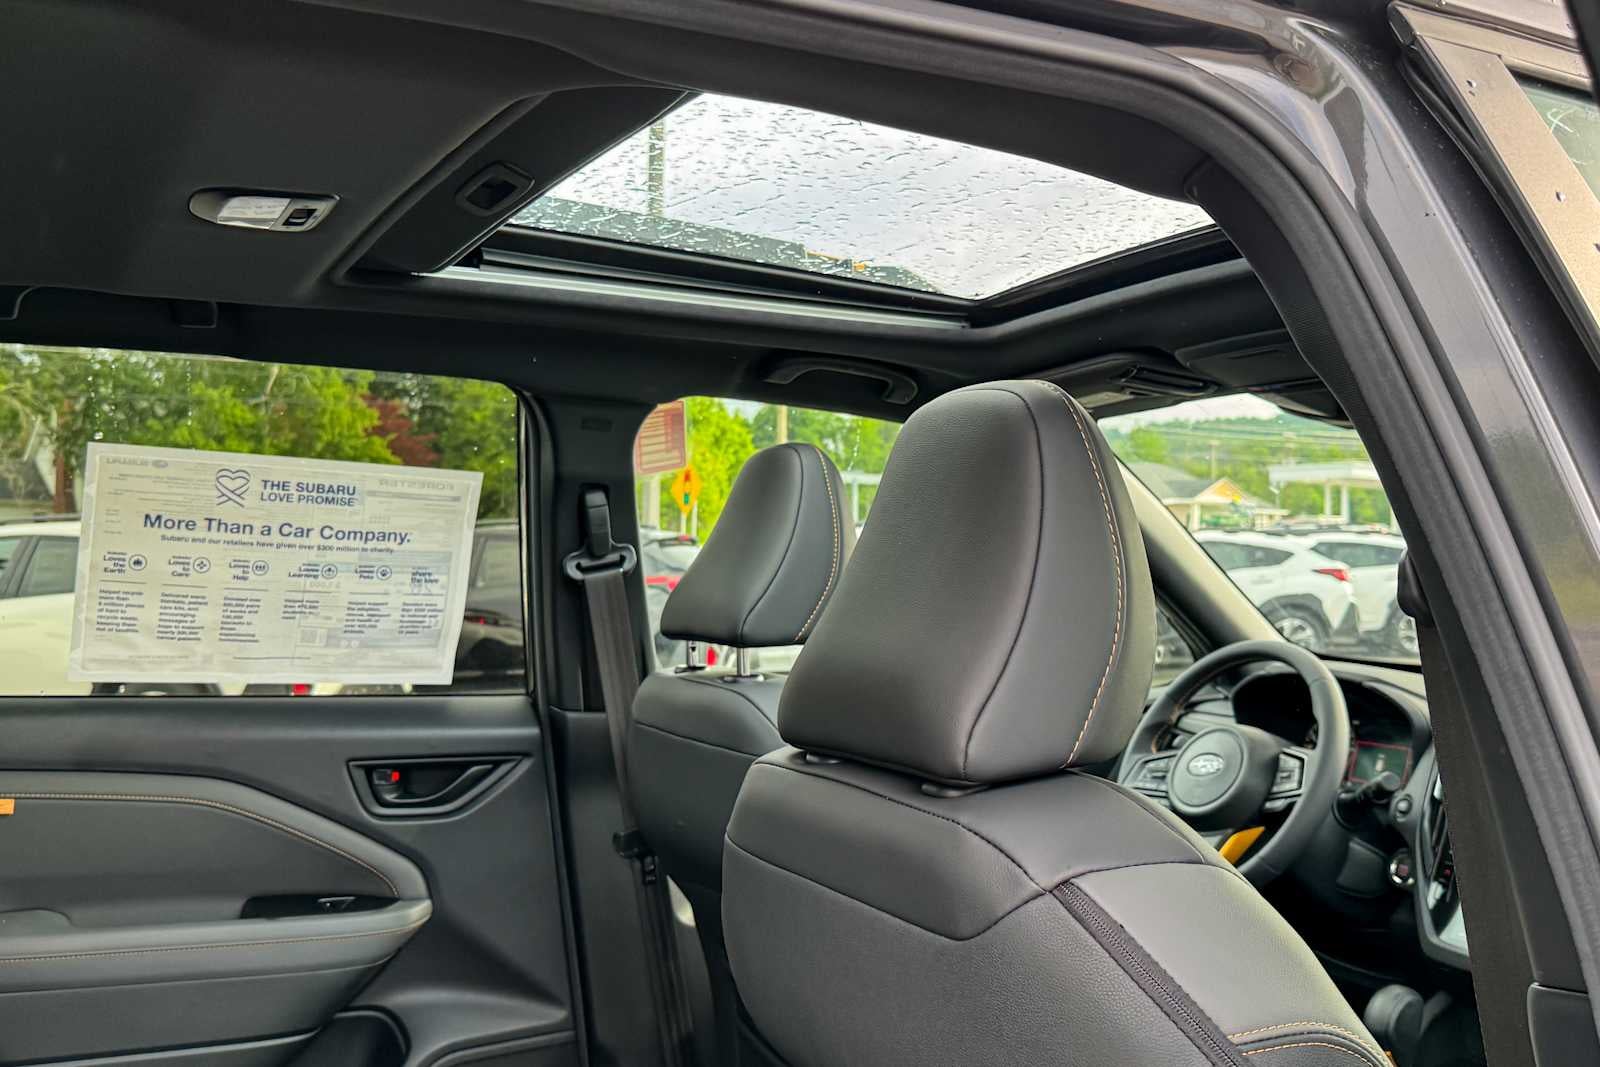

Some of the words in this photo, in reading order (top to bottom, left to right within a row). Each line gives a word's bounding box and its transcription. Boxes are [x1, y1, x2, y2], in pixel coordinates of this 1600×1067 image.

[261, 479, 292, 492] THE
[295, 481, 357, 496] SUBARU
[260, 491, 294, 503] LOVE
[297, 494, 356, 507] PROMISE
[143, 513, 197, 531] More
[204, 517, 254, 536] Than
[260, 523, 272, 537] a
[278, 522, 315, 539] Car
[319, 525, 411, 546] Company.
[160, 534, 190, 543] Subaru
[276, 542, 297, 550] given
